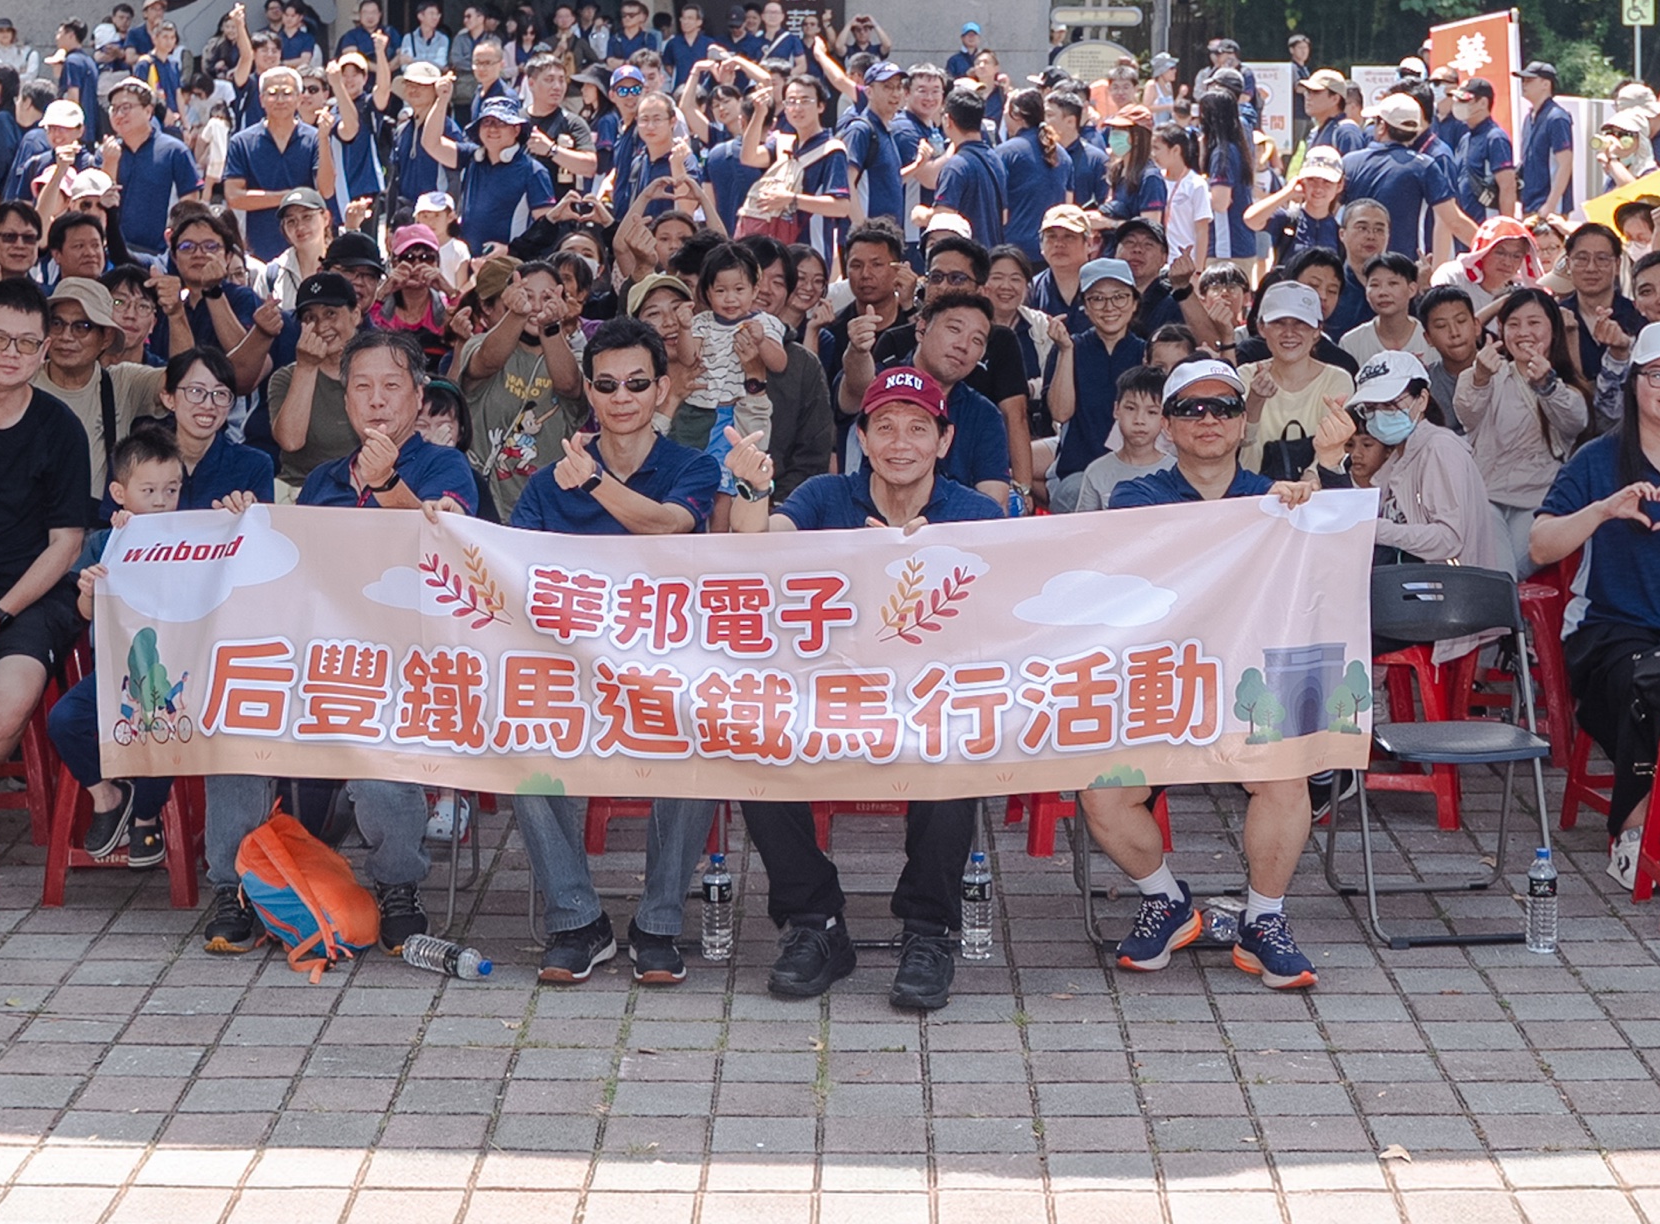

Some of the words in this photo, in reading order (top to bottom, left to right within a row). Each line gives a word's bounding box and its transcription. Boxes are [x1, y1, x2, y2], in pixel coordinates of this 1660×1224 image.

[1447, 31, 1493, 75] 華
[885, 373, 924, 390] NCKU
[122, 536, 243, 563] winbond
[530, 568, 852, 652] 華邦電子
[202, 642, 1217, 761] 后豐鐵馬道鐵馬行活動
